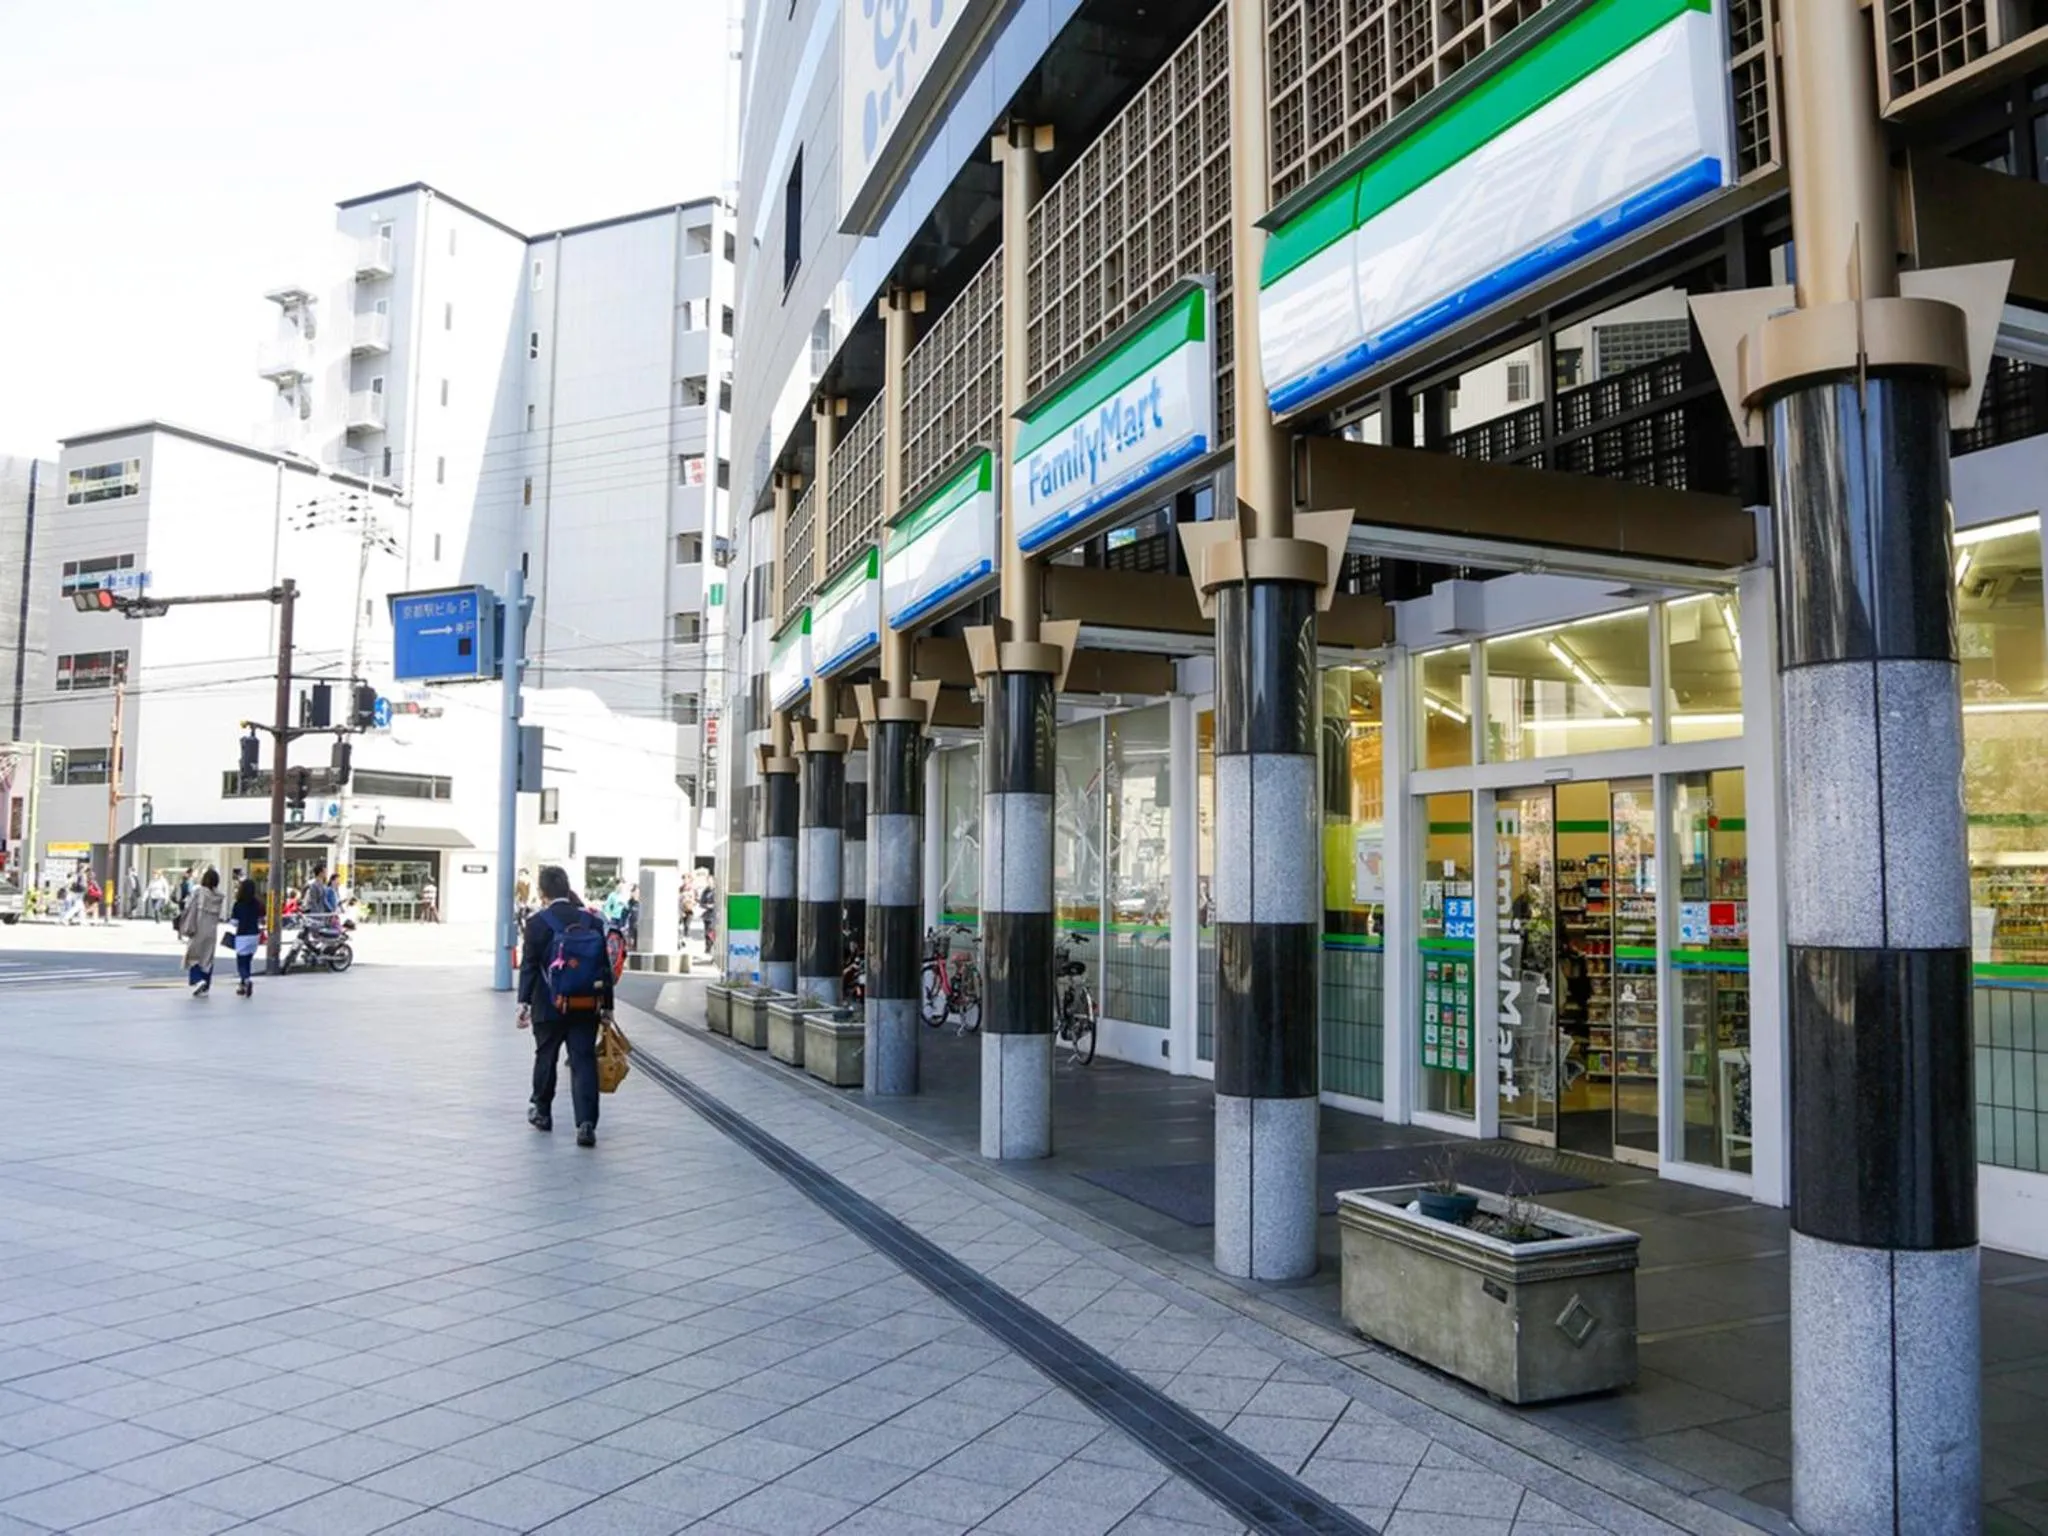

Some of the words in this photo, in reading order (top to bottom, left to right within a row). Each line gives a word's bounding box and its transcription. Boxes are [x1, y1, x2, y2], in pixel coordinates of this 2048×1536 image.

[1029, 376, 1163, 506] FamilyMart
[1444, 921, 1475, 938] たばこ
